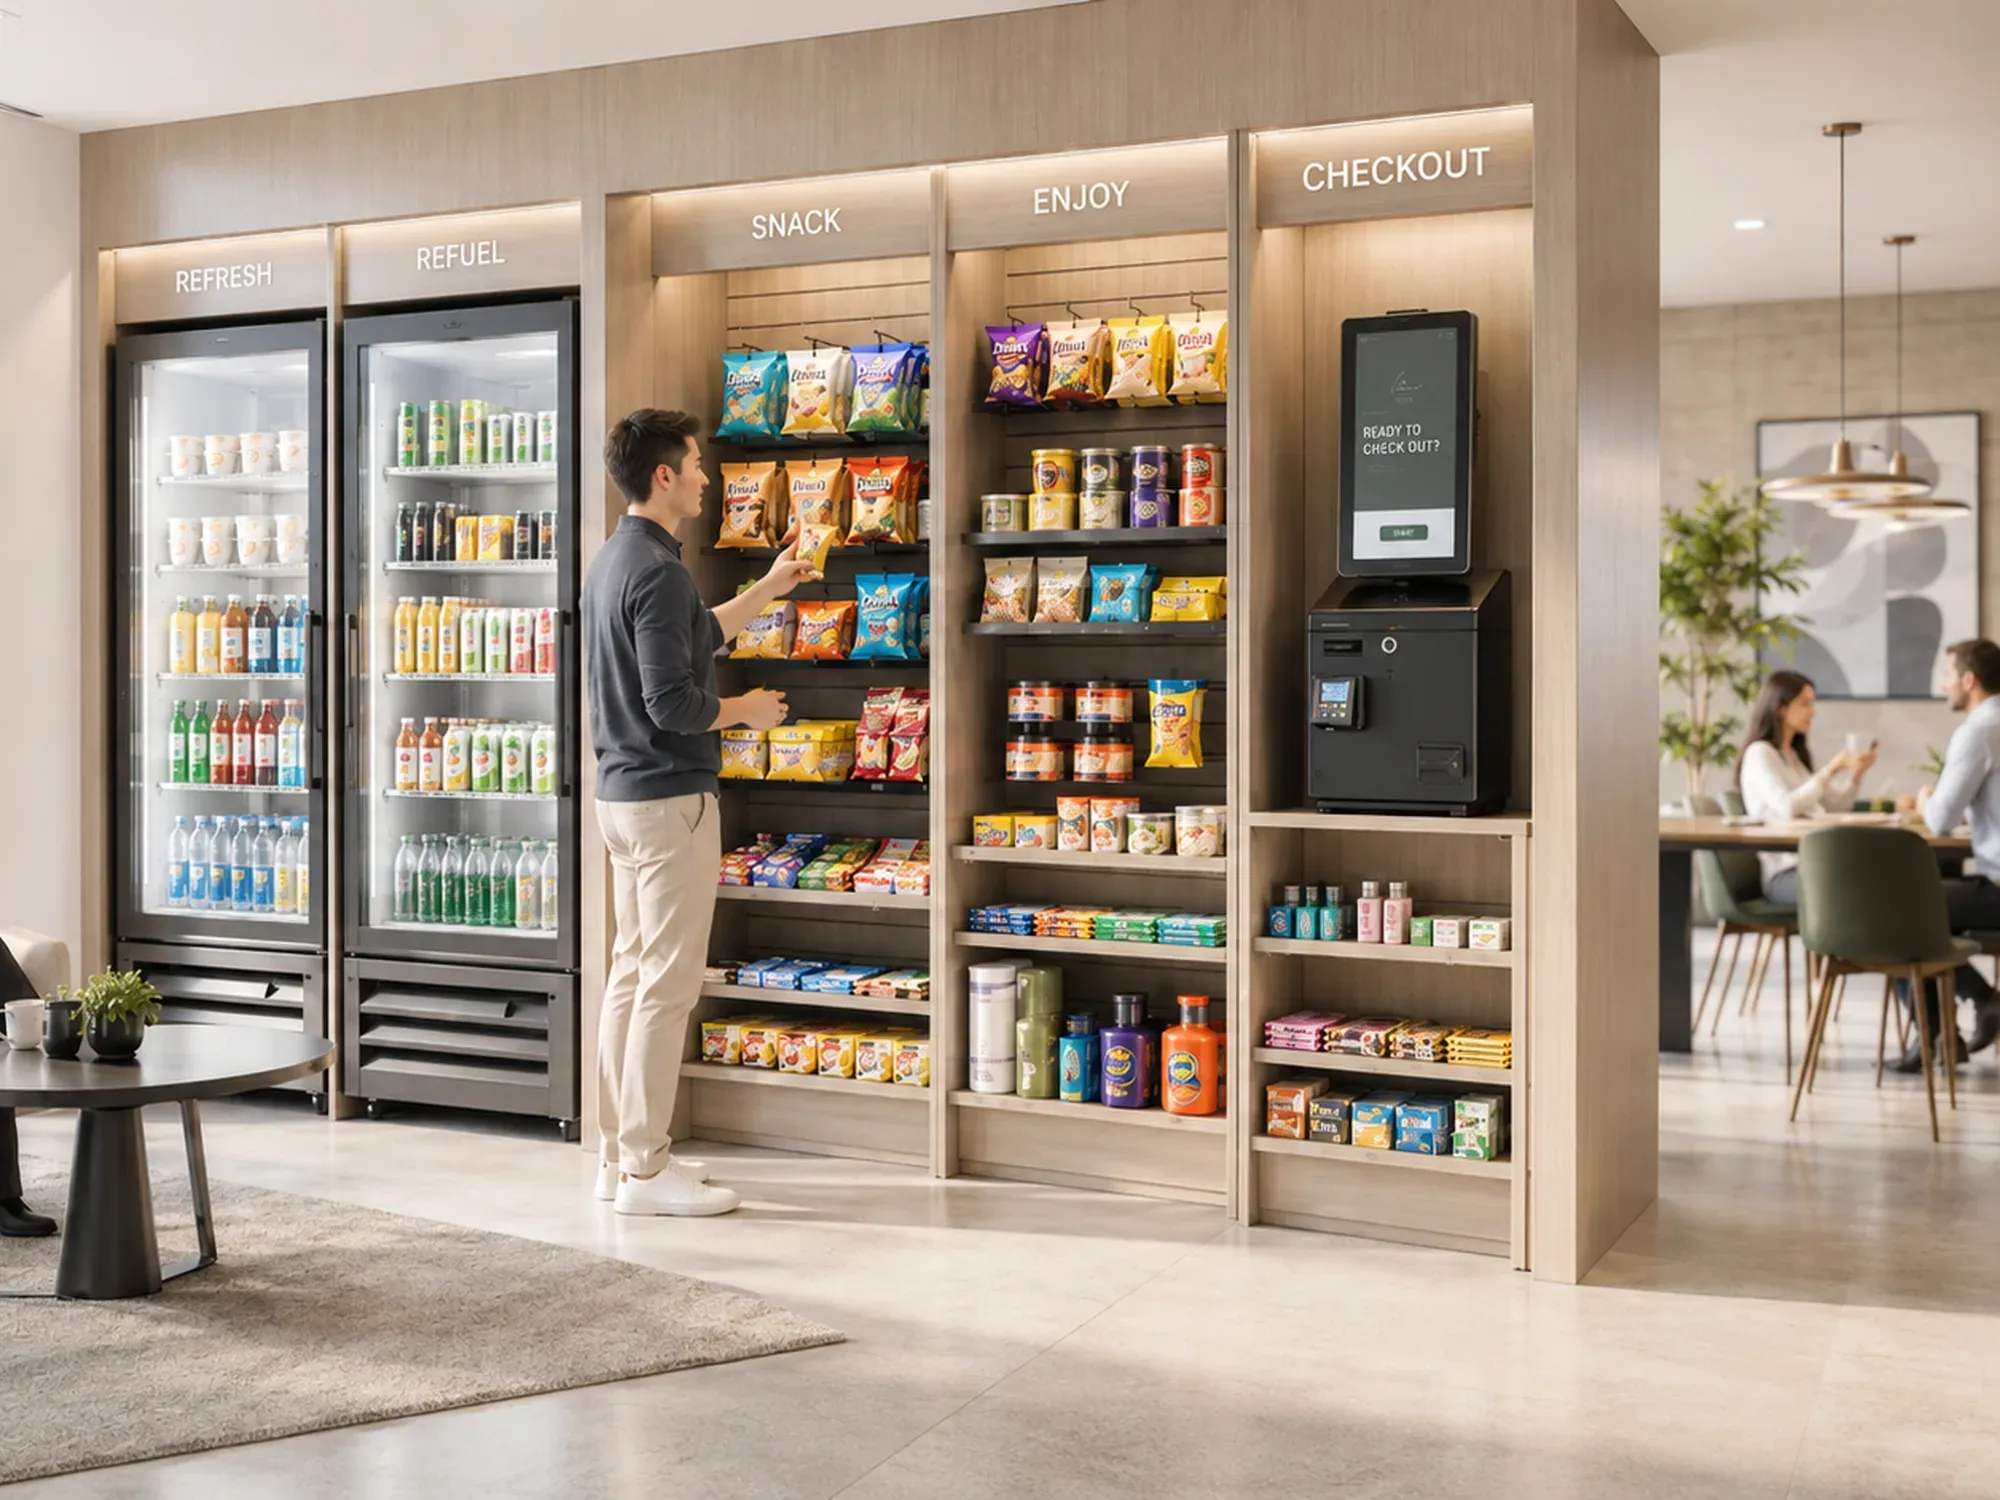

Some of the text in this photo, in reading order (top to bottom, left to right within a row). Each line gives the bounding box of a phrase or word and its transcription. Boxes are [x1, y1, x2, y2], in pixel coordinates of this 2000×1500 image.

[1302, 146, 1491, 192] CHECKOUT
[1033, 180, 1129, 215] ENJOY
[752, 206, 842, 240] SNACK
[416, 240, 506, 270] REFUEL
[175, 262, 273, 294] REFRESH
[1363, 423, 1421, 439] READY TO
[1363, 439, 1440, 455] CHECK OUT?
